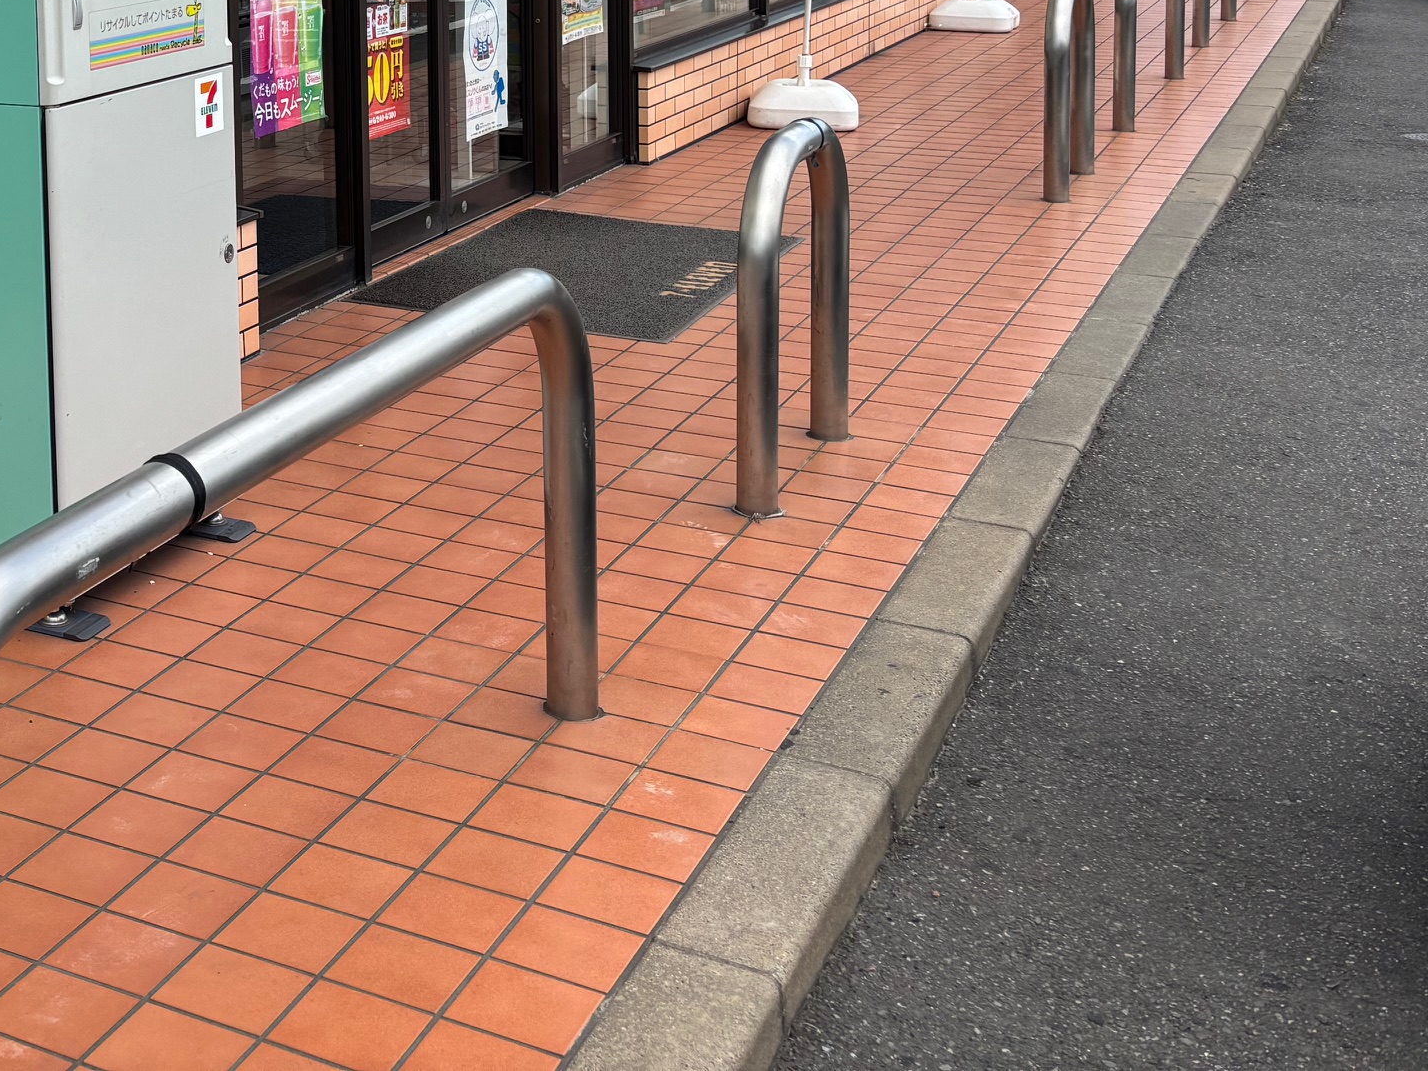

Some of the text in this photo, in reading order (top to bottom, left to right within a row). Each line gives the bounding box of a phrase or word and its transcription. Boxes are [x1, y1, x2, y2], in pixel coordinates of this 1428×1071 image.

[100, 6, 184, 33] リサイクルしてポイントたまる
[391, 50, 403, 81] 円
[253, 75, 300, 99] くだもの味わう!
[391, 81, 404, 102] 引き
[254, 88, 323, 128] 今日もスムージー!
